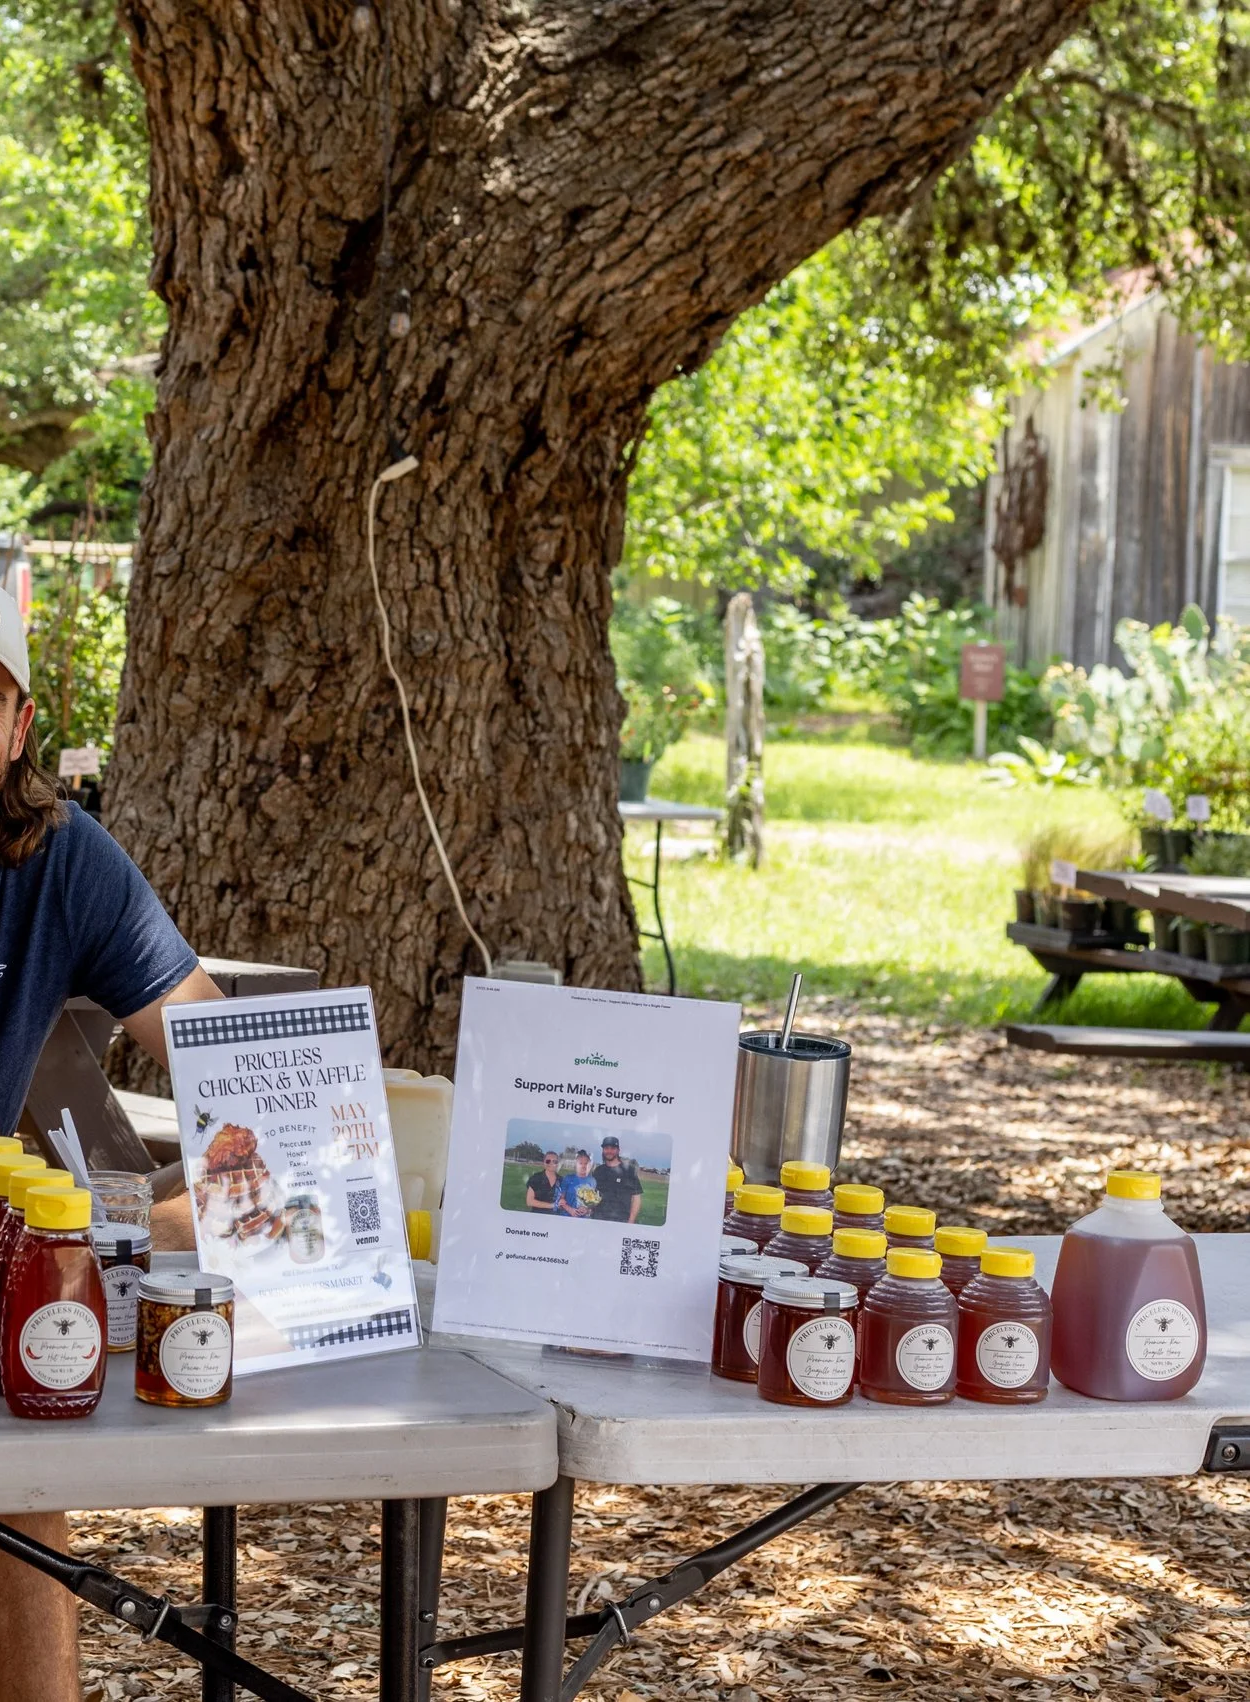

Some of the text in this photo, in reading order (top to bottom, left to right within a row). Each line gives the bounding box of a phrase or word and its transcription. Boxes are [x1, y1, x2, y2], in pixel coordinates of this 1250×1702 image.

[234, 1047, 323, 1073] PRICELESS
[574, 1056, 619, 1068] gofundme
[198, 1063, 367, 1098] CHICKEN & WAFFLE
[514, 1077, 675, 1105] Support Mila's Surgery for
[255, 1091, 318, 1114] DINNER
[331, 1102, 368, 1122] MAY
[547, 1098, 638, 1117] a Bright Future
[264, 1124, 317, 1139] TO BENEFIT
[355, 1236, 380, 1246] venmo
[505, 1227, 531, 1237] Donate
[31, 1306, 94, 1330] PRICELESS HONEY
[1136, 1305, 1191, 1328] PRICELESS HONEY
[171, 1318, 229, 1340] PRICELESS HONEY
[798, 1321, 853, 1343] PRICELESS HONEY
[905, 1329, 936, 1346] PRICELESS
[985, 1326, 1016, 1343] PRICELESS
[176, 1380, 209, 1394] SOUTHWEST
[803, 1381, 833, 1396] SOUTHWEST
